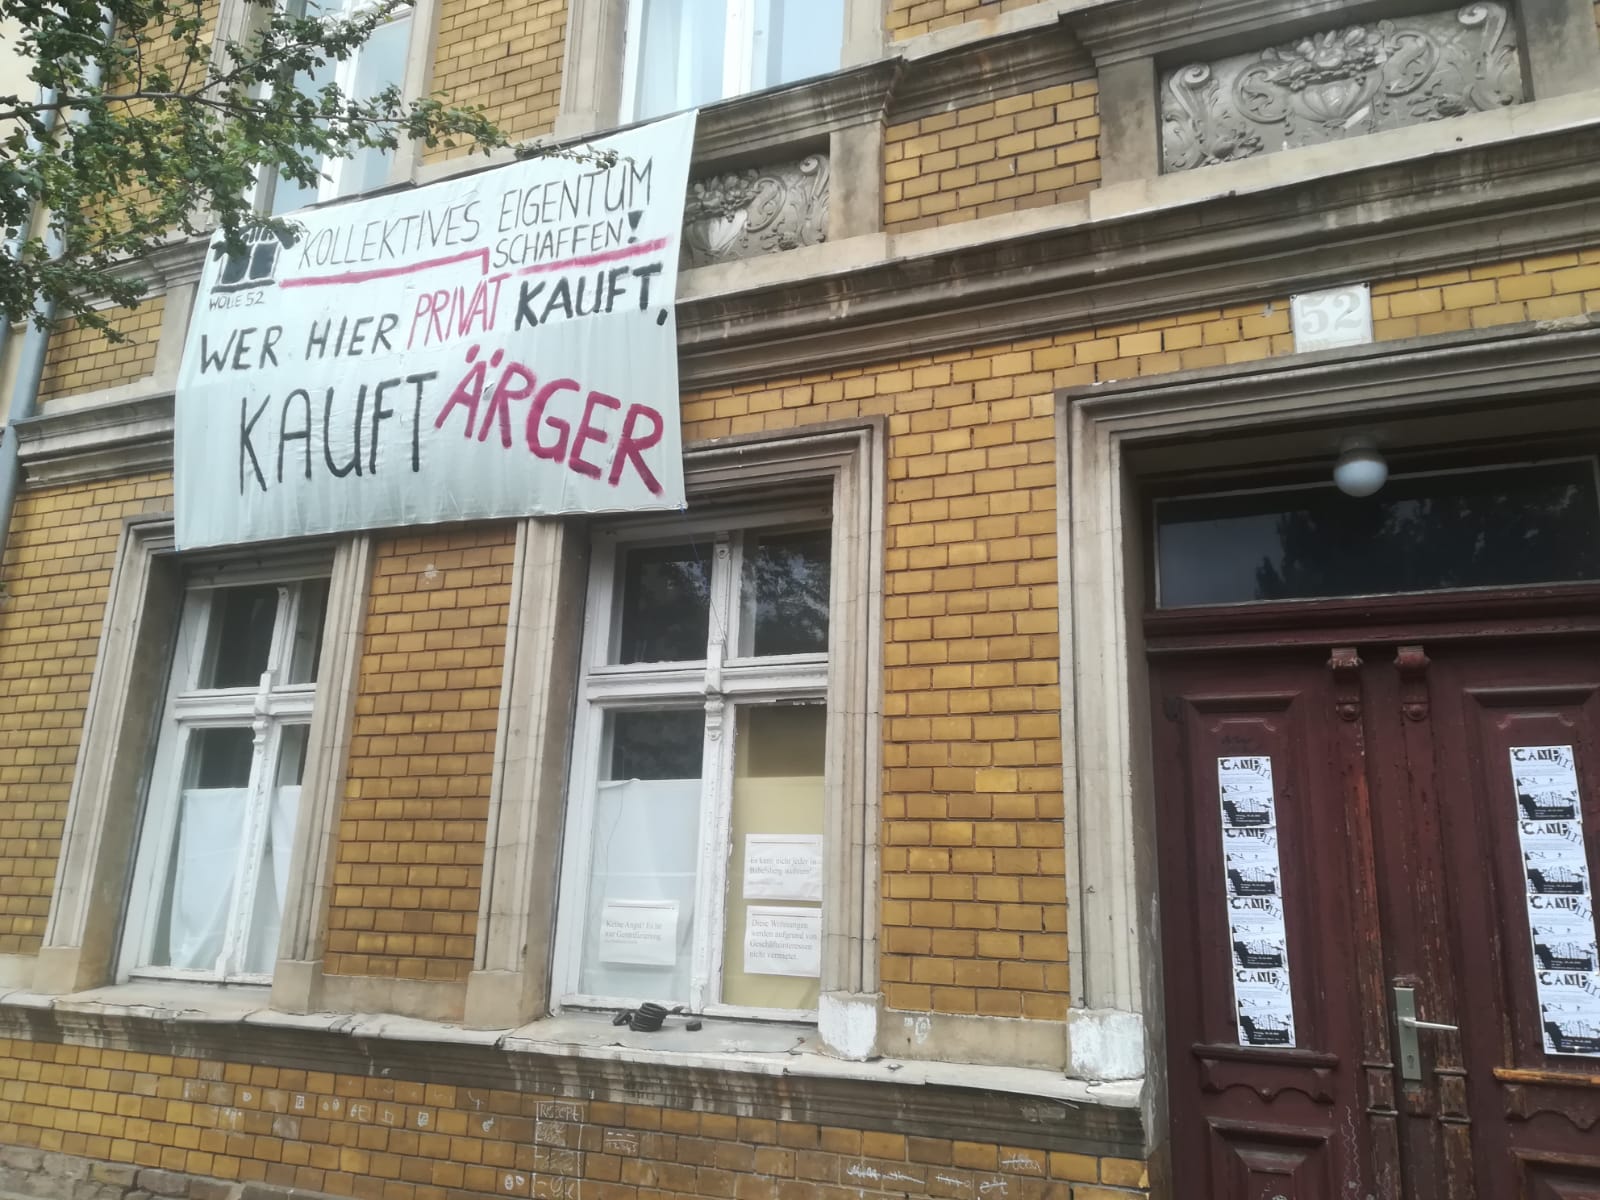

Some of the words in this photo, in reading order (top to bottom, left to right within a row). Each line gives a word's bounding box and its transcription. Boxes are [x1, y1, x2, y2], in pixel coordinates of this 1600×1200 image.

[298, 200, 481, 270] KOLLEKTIVES
[497, 157, 652, 233] EIGENTUM
[493, 210, 643, 268] SCHAFFEN!
[200, 324, 285, 375] WER
[304, 312, 399, 361] HIER
[406, 273, 511, 350] PRIVAT
[245, 290, 264, 306] 52
[1301, 291, 1362, 335] 52
[240, 371, 439, 495] KAUFT
[434, 344, 665, 496] ÄRGER
